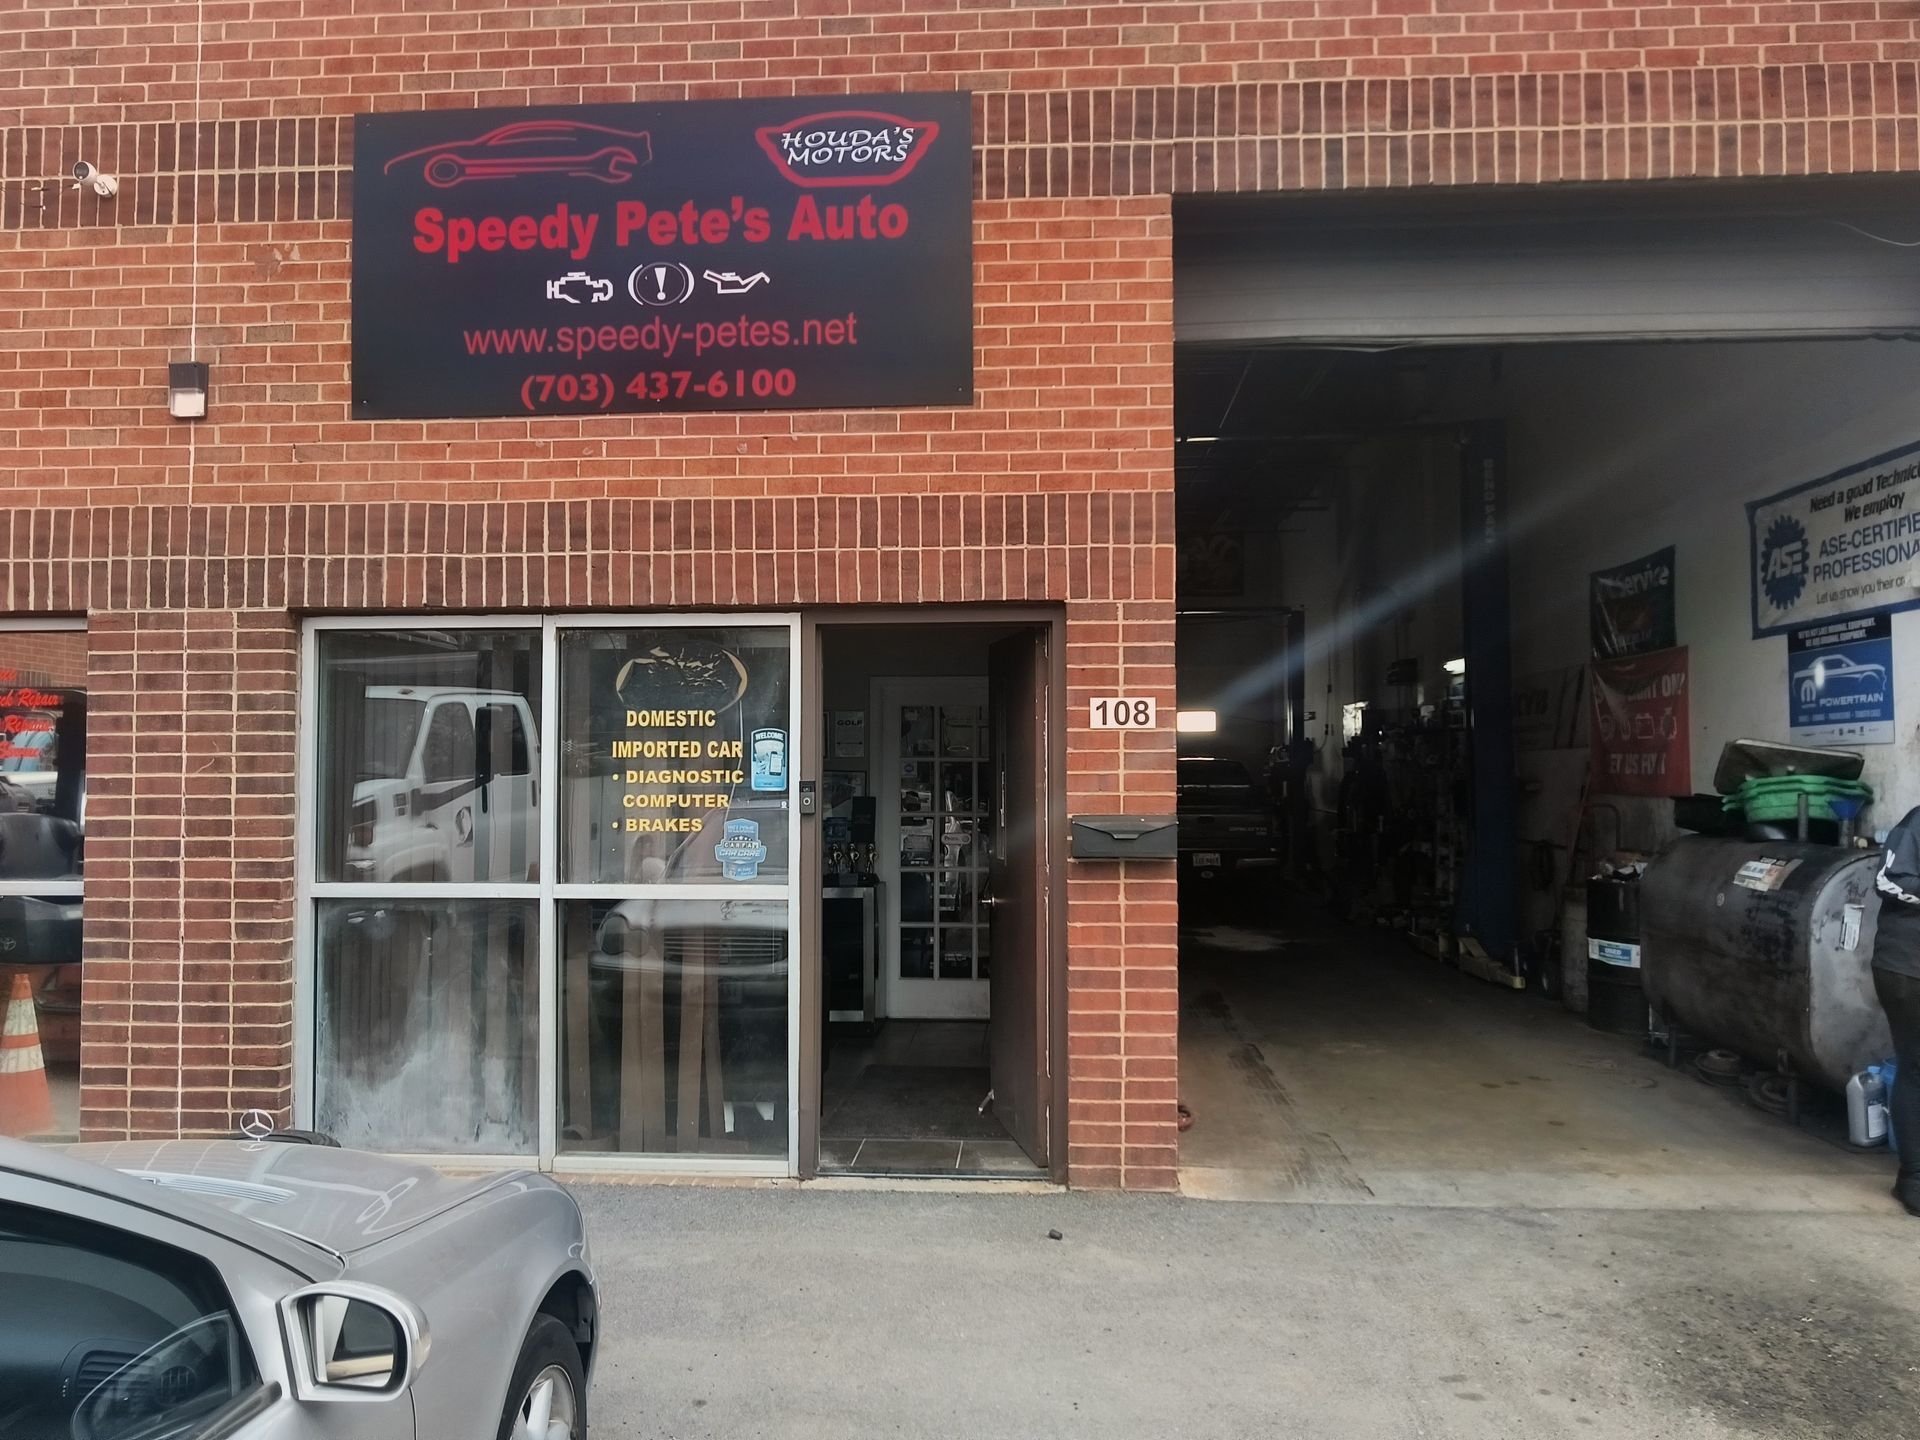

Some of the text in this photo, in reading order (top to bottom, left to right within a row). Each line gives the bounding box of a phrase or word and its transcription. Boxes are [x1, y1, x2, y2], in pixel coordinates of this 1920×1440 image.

[782, 126, 914, 150] HOUDA'S
[787, 143, 908, 166] MOTORS
[413, 194, 909, 264] Speedy Pete's Auto
[463, 312, 858, 360] www.speedy-petes.net
[520, 367, 797, 410] (703) 437-6100
[1810, 490, 1836, 513] Need
[1837, 491, 1844, 504] a
[1846, 477, 1873, 504] good
[1845, 492, 1905, 523] We employ
[1766, 541, 1803, 581] ASE
[1861, 582, 1876, 596] you
[1661, 672, 1685, 697] ON?
[1820, 693, 1883, 707] POWERTRAIN
[626, 709, 716, 727] DOMESTIC
[837, 719, 863, 727] GOLF
[1095, 700, 1150, 726] 108
[755, 732, 784, 741] WELCOME
[612, 740, 743, 758] IMPORTED CAR
[626, 770, 744, 784] DIAGNOSTIC
[623, 794, 729, 808] COMPUTER
[626, 818, 702, 832] BRAKES
